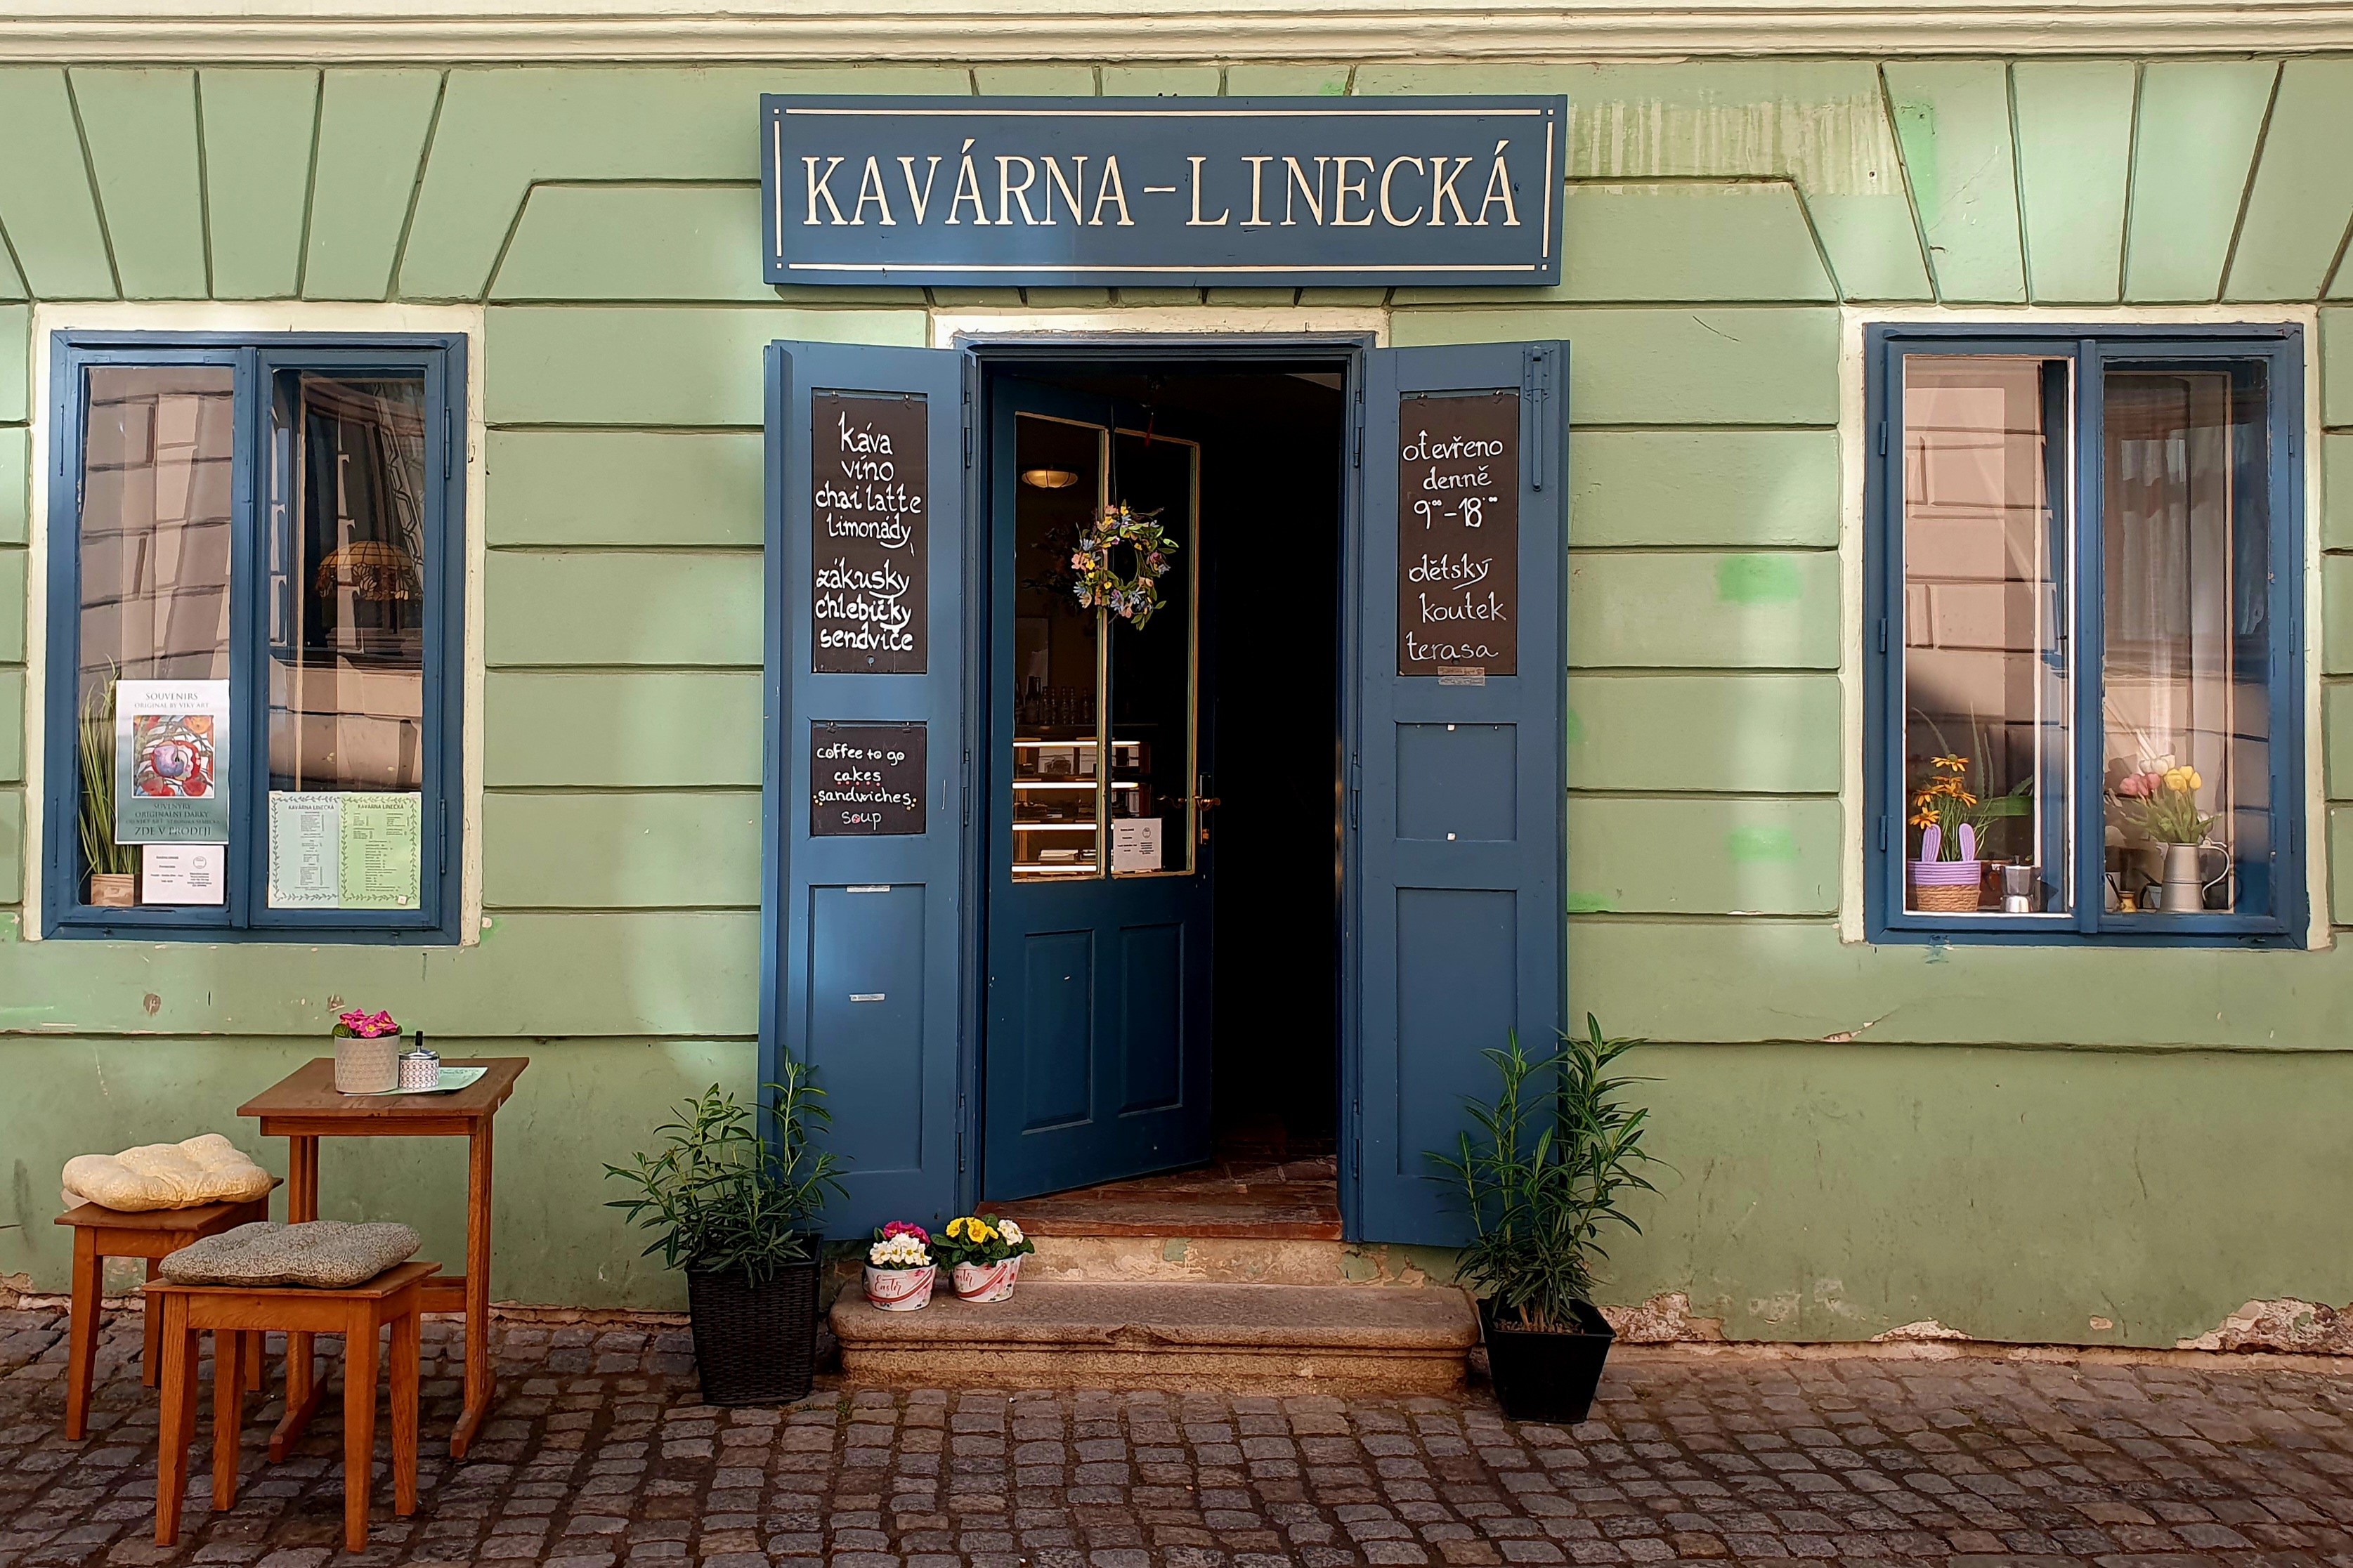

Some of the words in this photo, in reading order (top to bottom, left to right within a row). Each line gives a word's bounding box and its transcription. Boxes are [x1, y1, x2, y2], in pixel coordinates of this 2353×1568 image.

[837, 411, 893, 455] káva
[1402, 430, 1503, 462] otevřeno
[841, 455, 894, 481] víno
[1422, 464, 1492, 490] denně
[815, 480, 862, 509] chai
[866, 483, 921, 514] latte
[826, 512, 911, 549] limonády
[816, 556, 910, 599] zákusky
[1409, 553, 1493, 590] dětský
[1419, 592, 1506, 624] koutek
[1405, 631, 1499, 660] terasa
[816, 742, 863, 759] coffee
[866, 749, 882, 759] to
[887, 752, 905, 766] go
[834, 766, 881, 781] cakes
[818, 786, 911, 805] sandwiches
[135, 827, 155, 835] ZDE
[158, 827, 166, 835] V
[169, 827, 211, 836] PRODEJI
[875, 1274, 904, 1295] Easter
